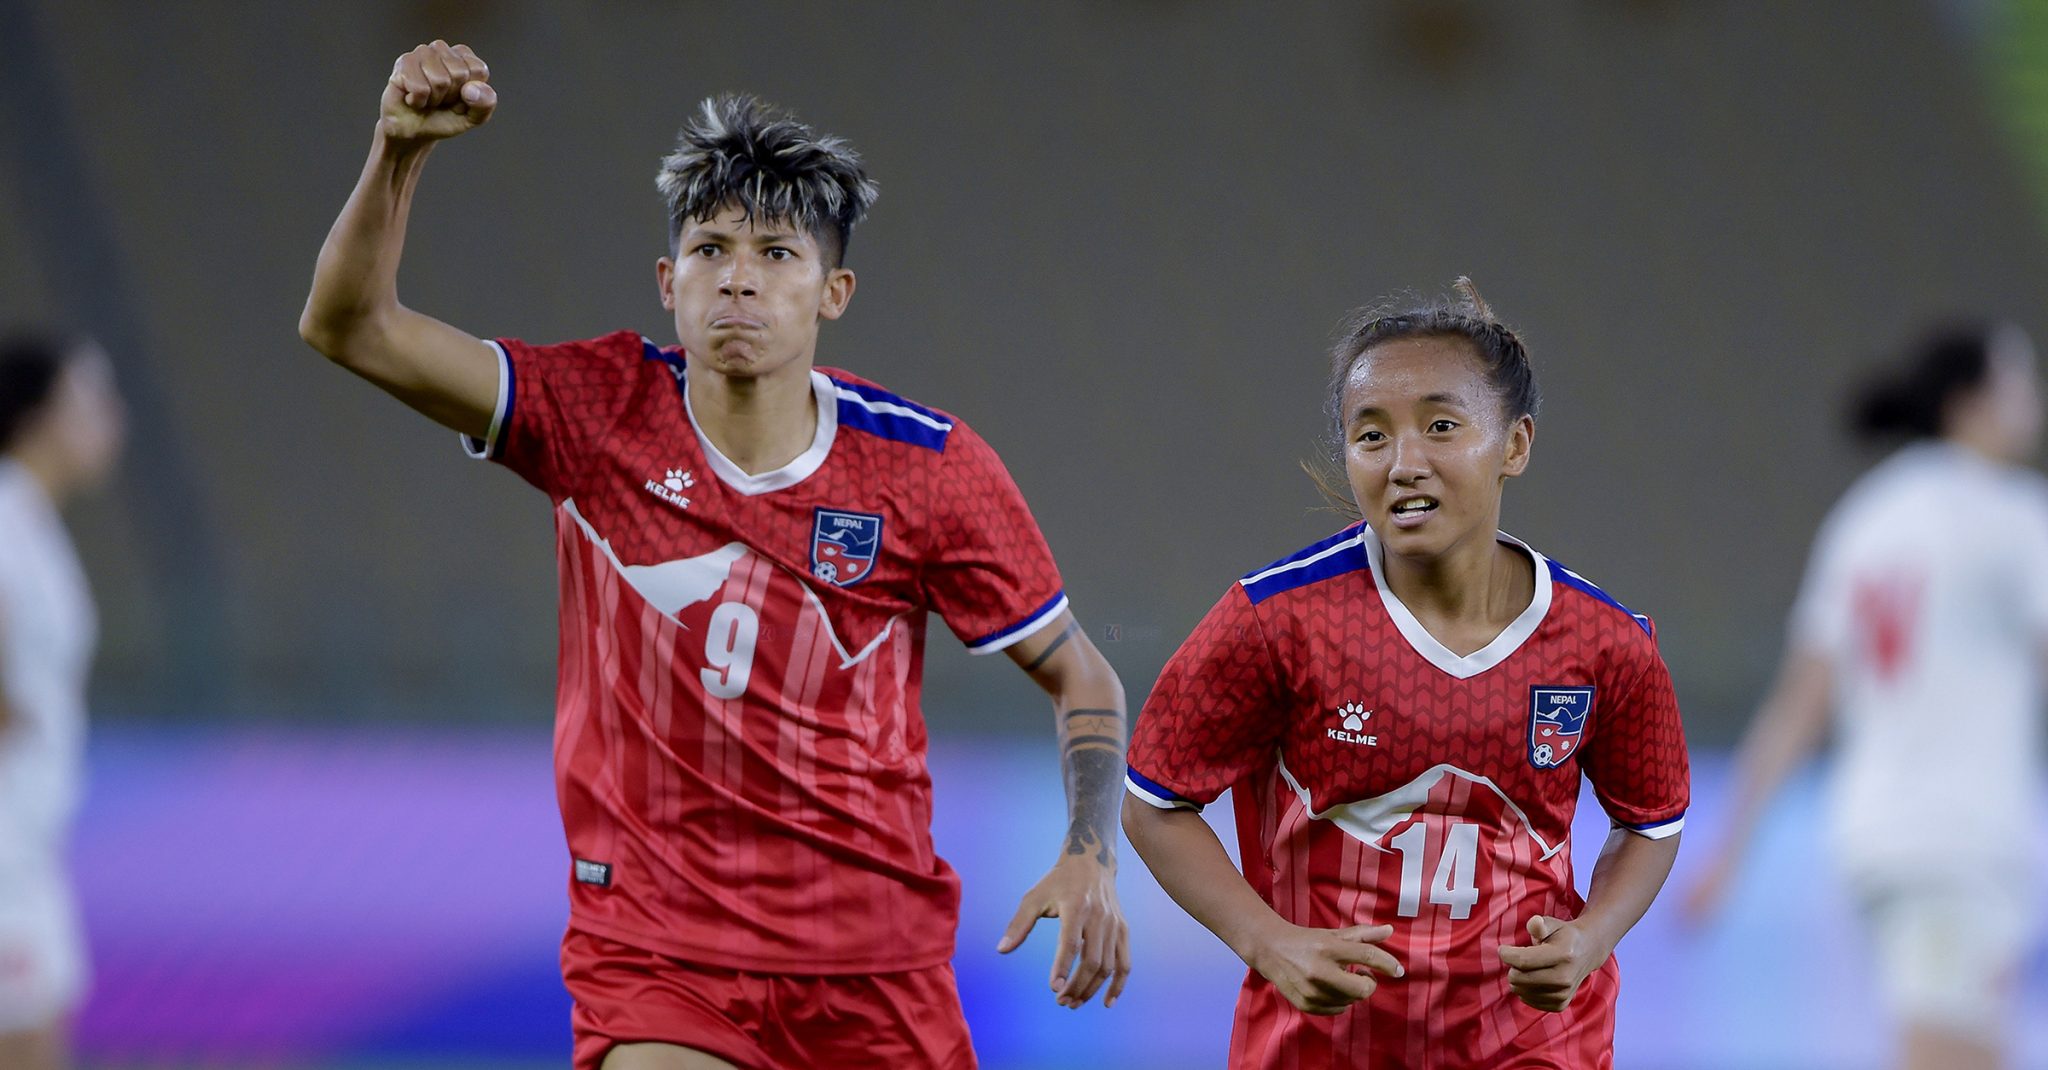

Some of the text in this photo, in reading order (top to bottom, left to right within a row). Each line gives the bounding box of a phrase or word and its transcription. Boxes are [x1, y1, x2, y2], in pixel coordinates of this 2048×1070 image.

[645, 479, 691, 509] KELME
[833, 517, 863, 530] NEPAL
[700, 601, 759, 699] 9
[1550, 695, 1577, 705] NEPAL
[1327, 728, 1377, 747] KELME
[1390, 822, 1479, 920] 14
